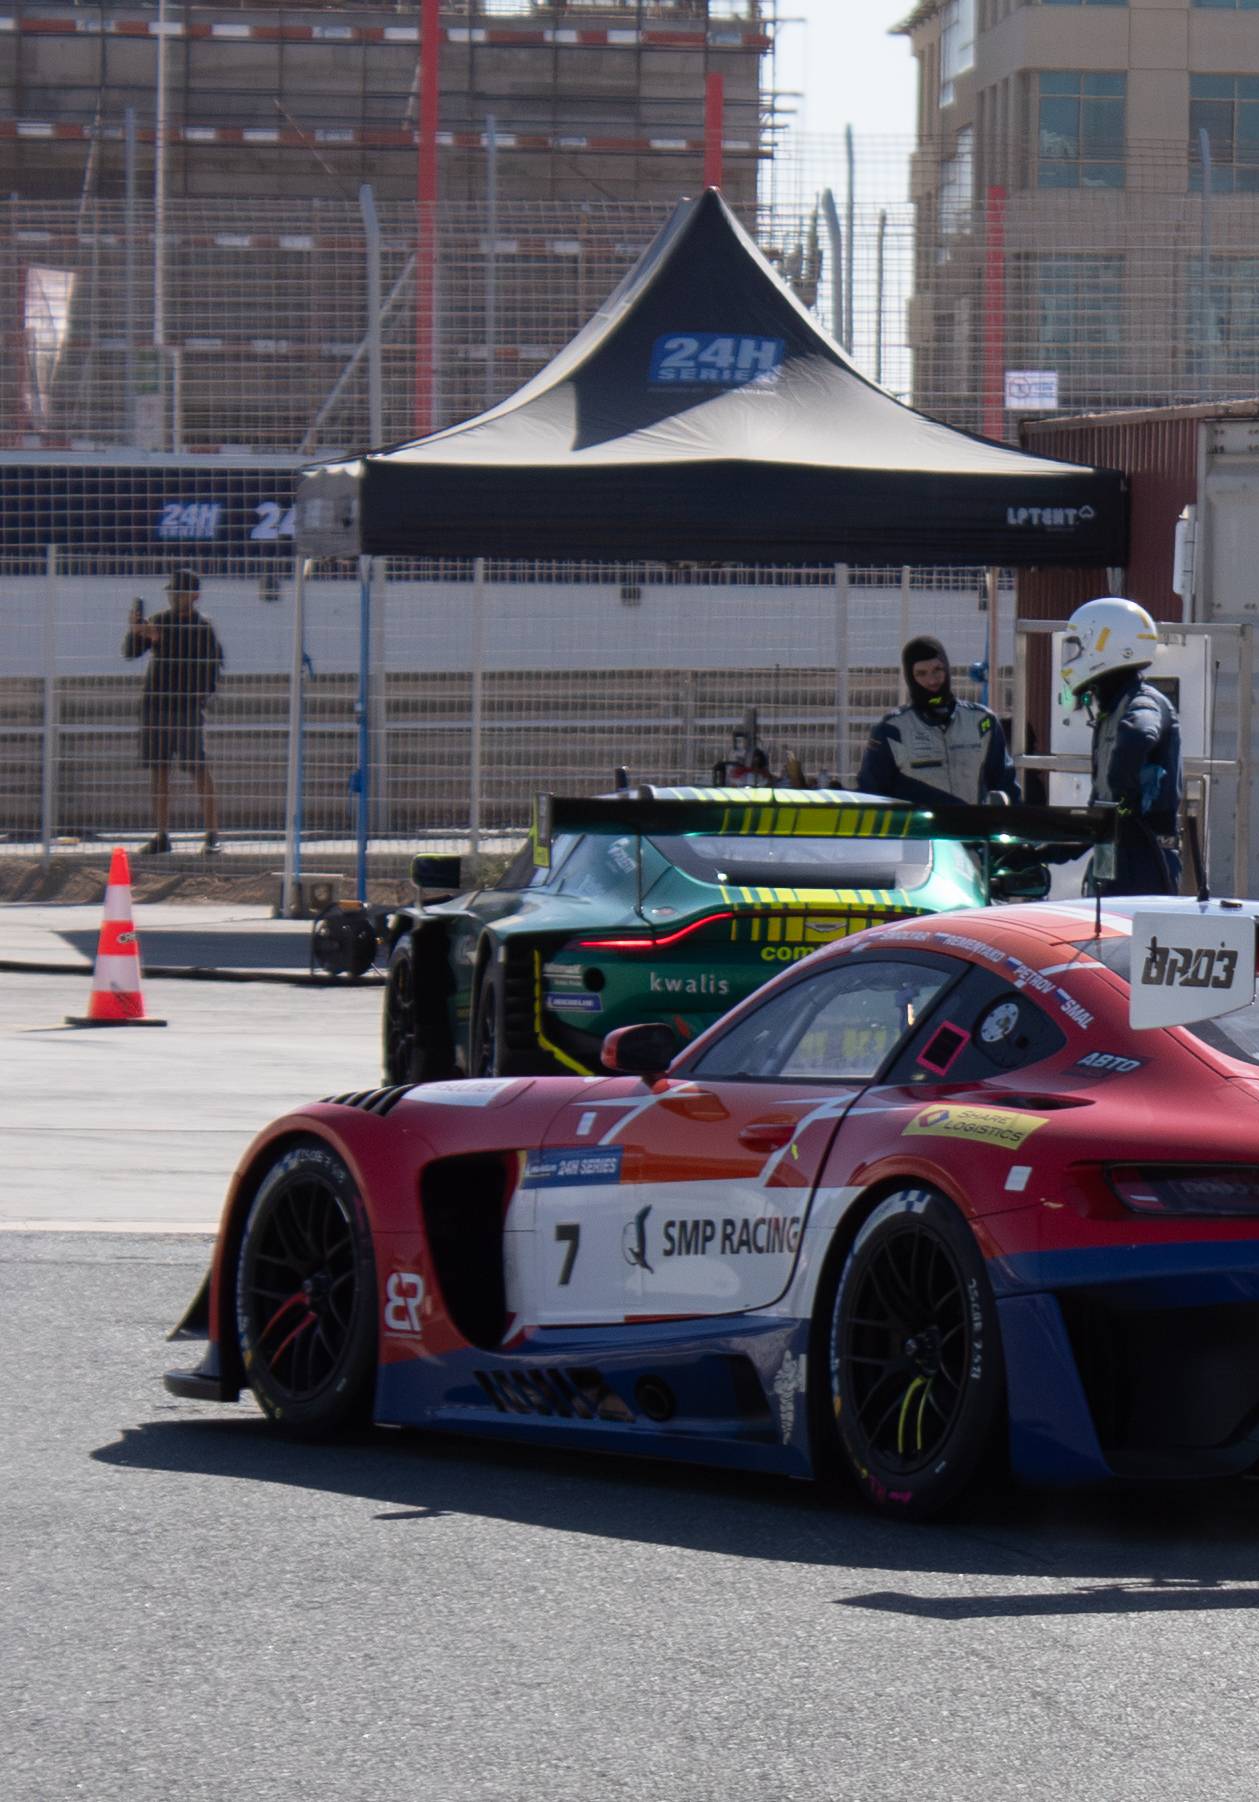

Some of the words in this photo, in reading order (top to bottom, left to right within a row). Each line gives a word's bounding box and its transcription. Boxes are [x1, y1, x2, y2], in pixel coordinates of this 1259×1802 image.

[660, 337, 777, 369] 24H
[650, 972, 730, 994] kwalis
[943, 1120, 1026, 1142] LOGISTICS
[957, 1110, 1012, 1125] SHARE
[663, 1219, 716, 1257] SMP
[720, 1216, 801, 1255] RACING
[555, 1223, 580, 1286] 7
